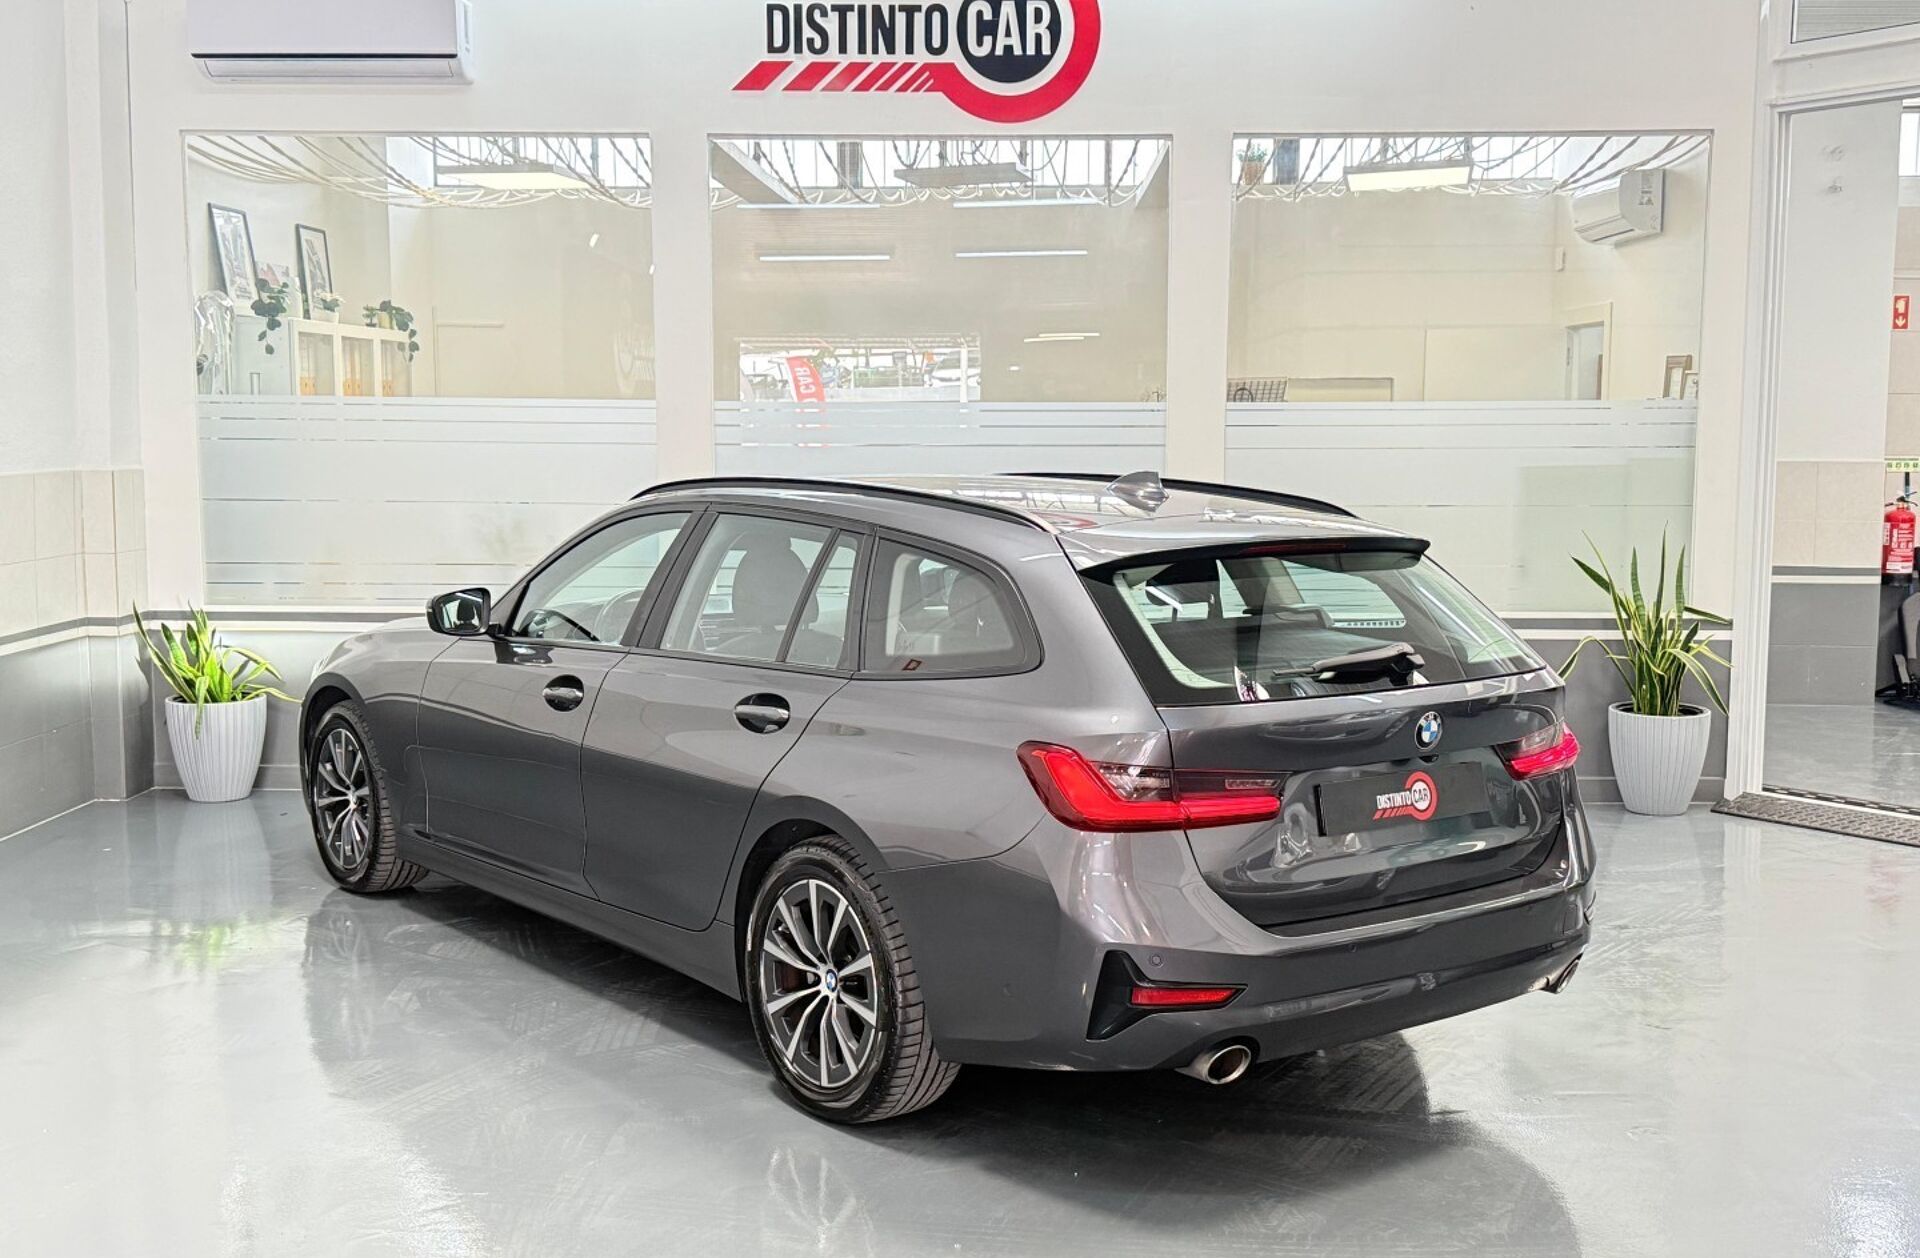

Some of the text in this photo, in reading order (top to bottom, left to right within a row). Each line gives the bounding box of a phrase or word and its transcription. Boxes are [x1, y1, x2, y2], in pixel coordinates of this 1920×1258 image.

[766, 0, 1052, 57] DISTINTO CAR
[1413, 788, 1428, 803] CAR
